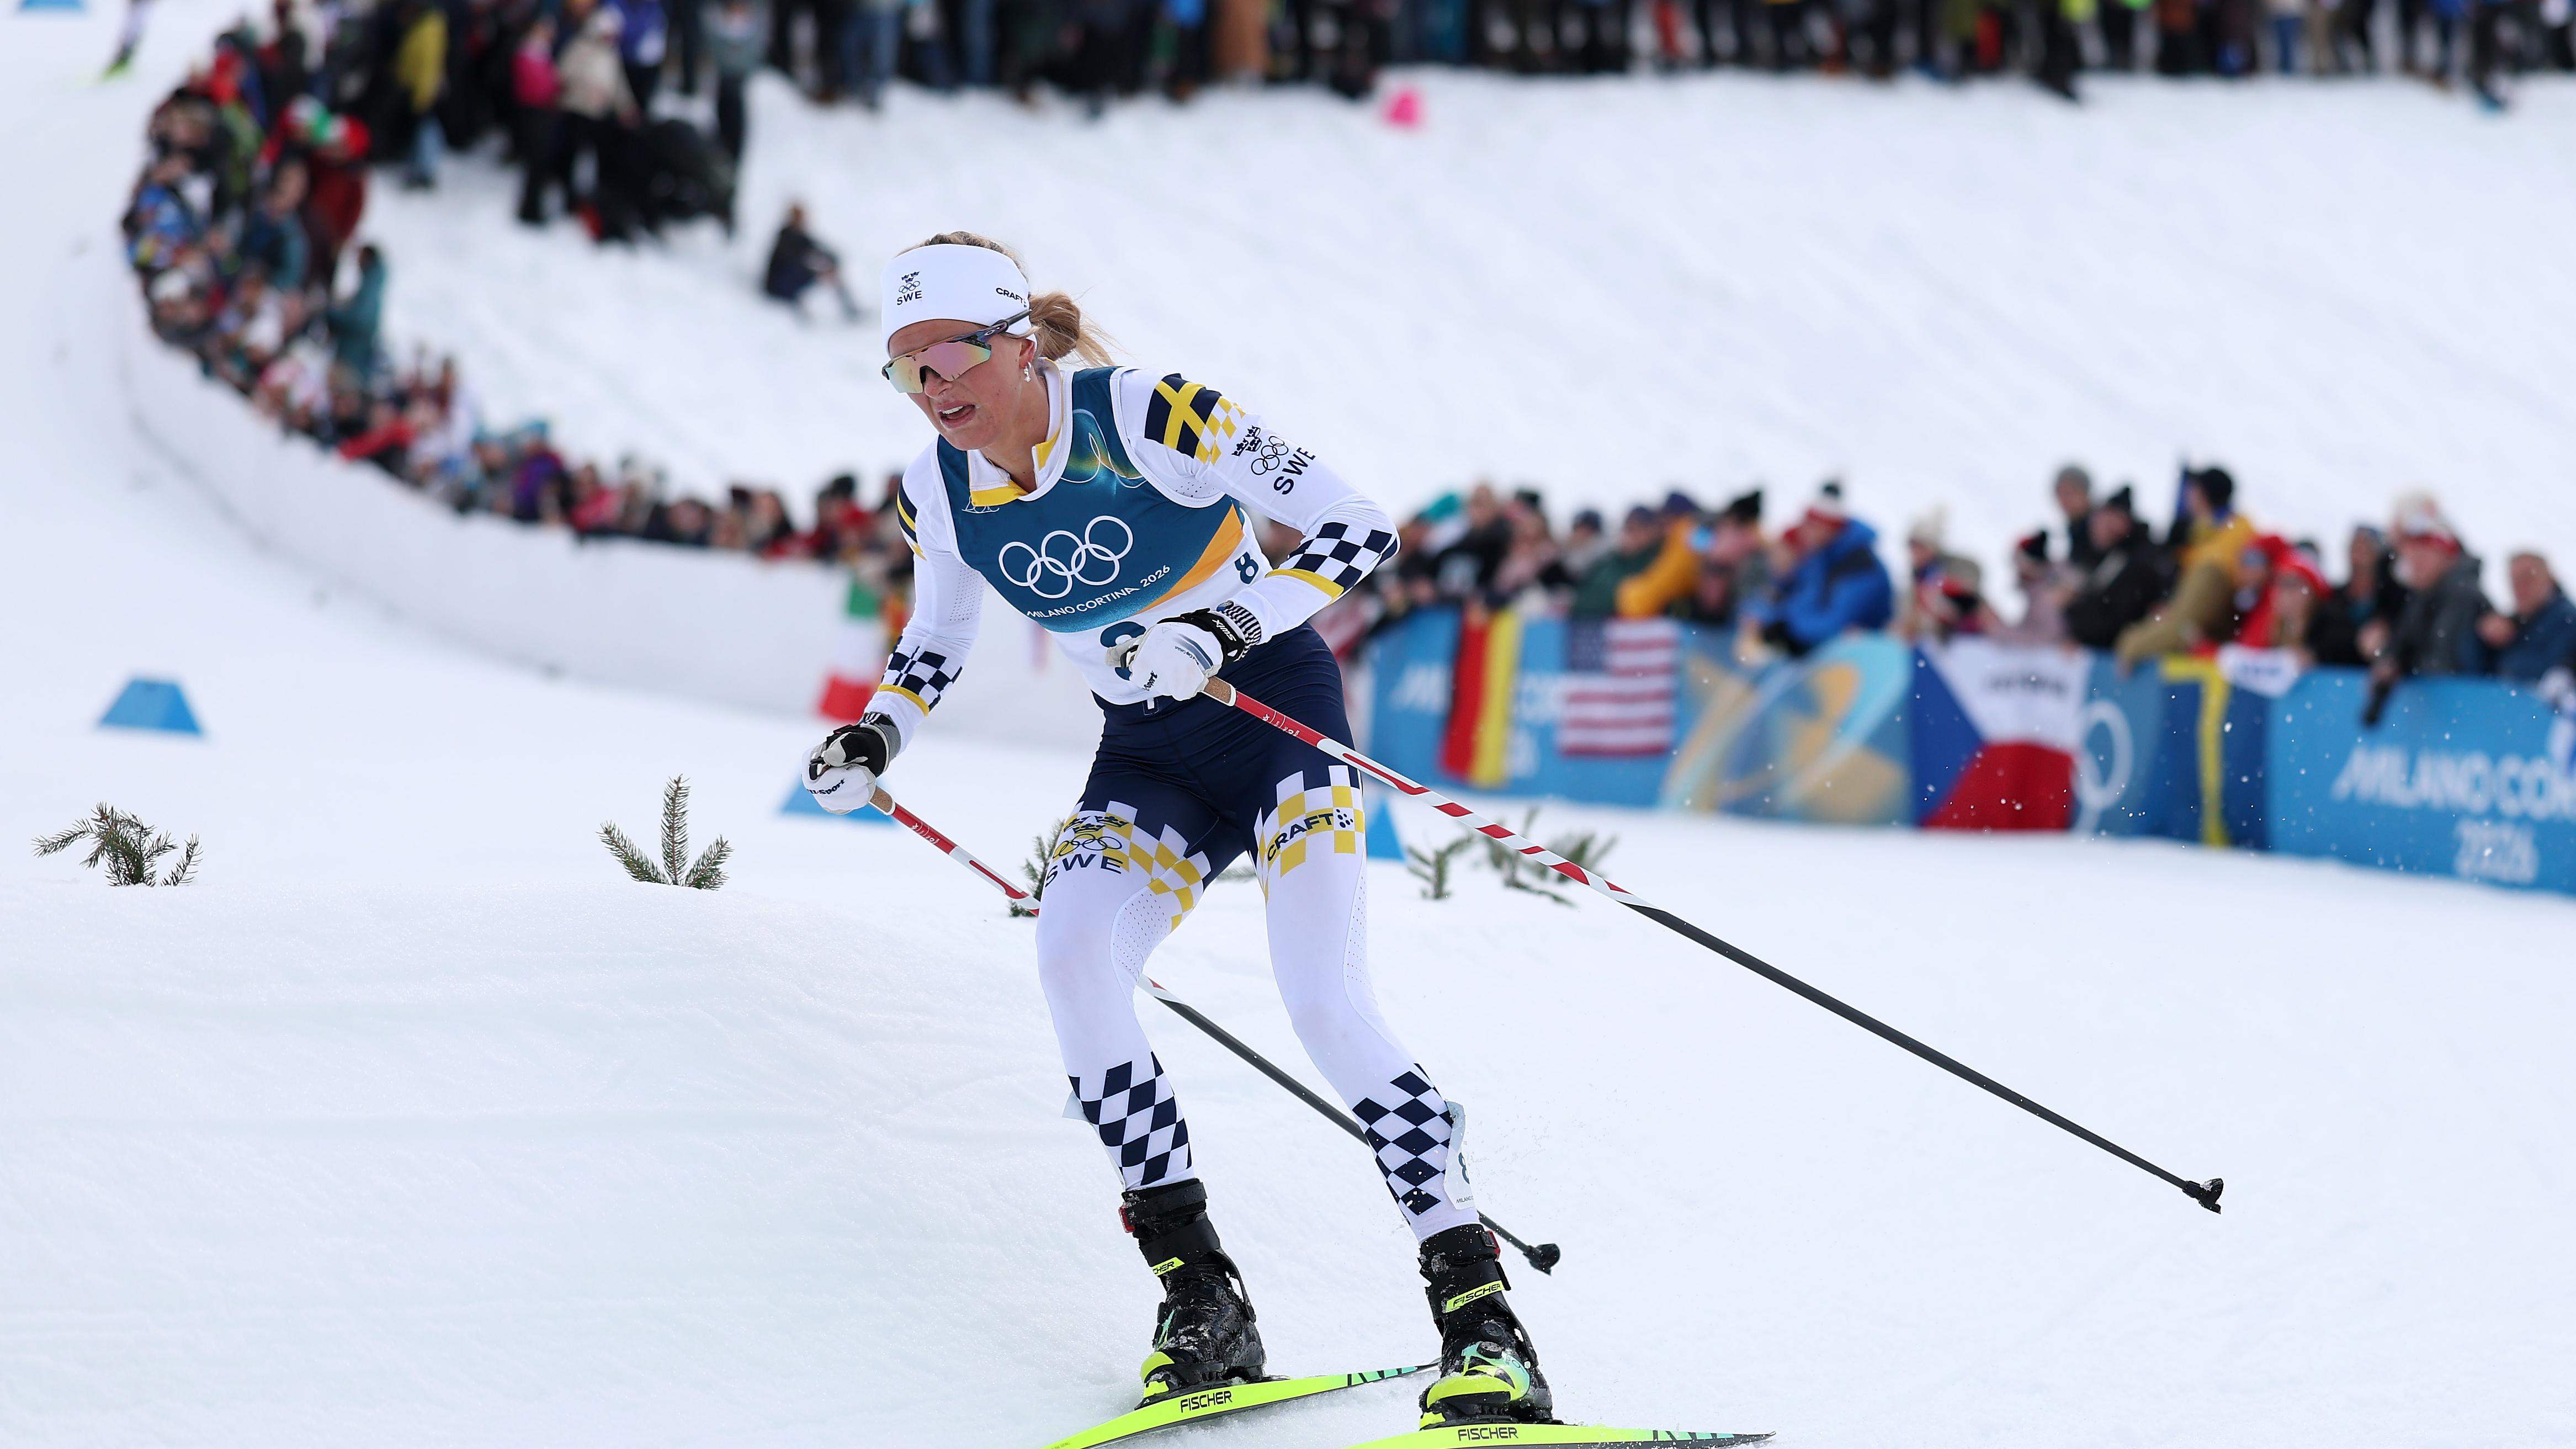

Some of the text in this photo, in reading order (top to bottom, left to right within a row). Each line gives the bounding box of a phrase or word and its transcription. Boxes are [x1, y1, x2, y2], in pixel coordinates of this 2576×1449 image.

[897, 290, 922, 305] SWE
[996, 288, 1023, 303] CRAFT
[1273, 447, 1316, 495] SWE
[1234, 551, 1258, 584] 8
[1027, 565, 1170, 618] MILANO CORTINA 2026
[1267, 813, 1334, 861] CRAFT
[1045, 853, 1123, 888] SWE
[1453, 1283, 1501, 1308] FISCHER
[1181, 1390, 1233, 1413] FISCHER
[1458, 1427, 1518, 1441] FISCHER
